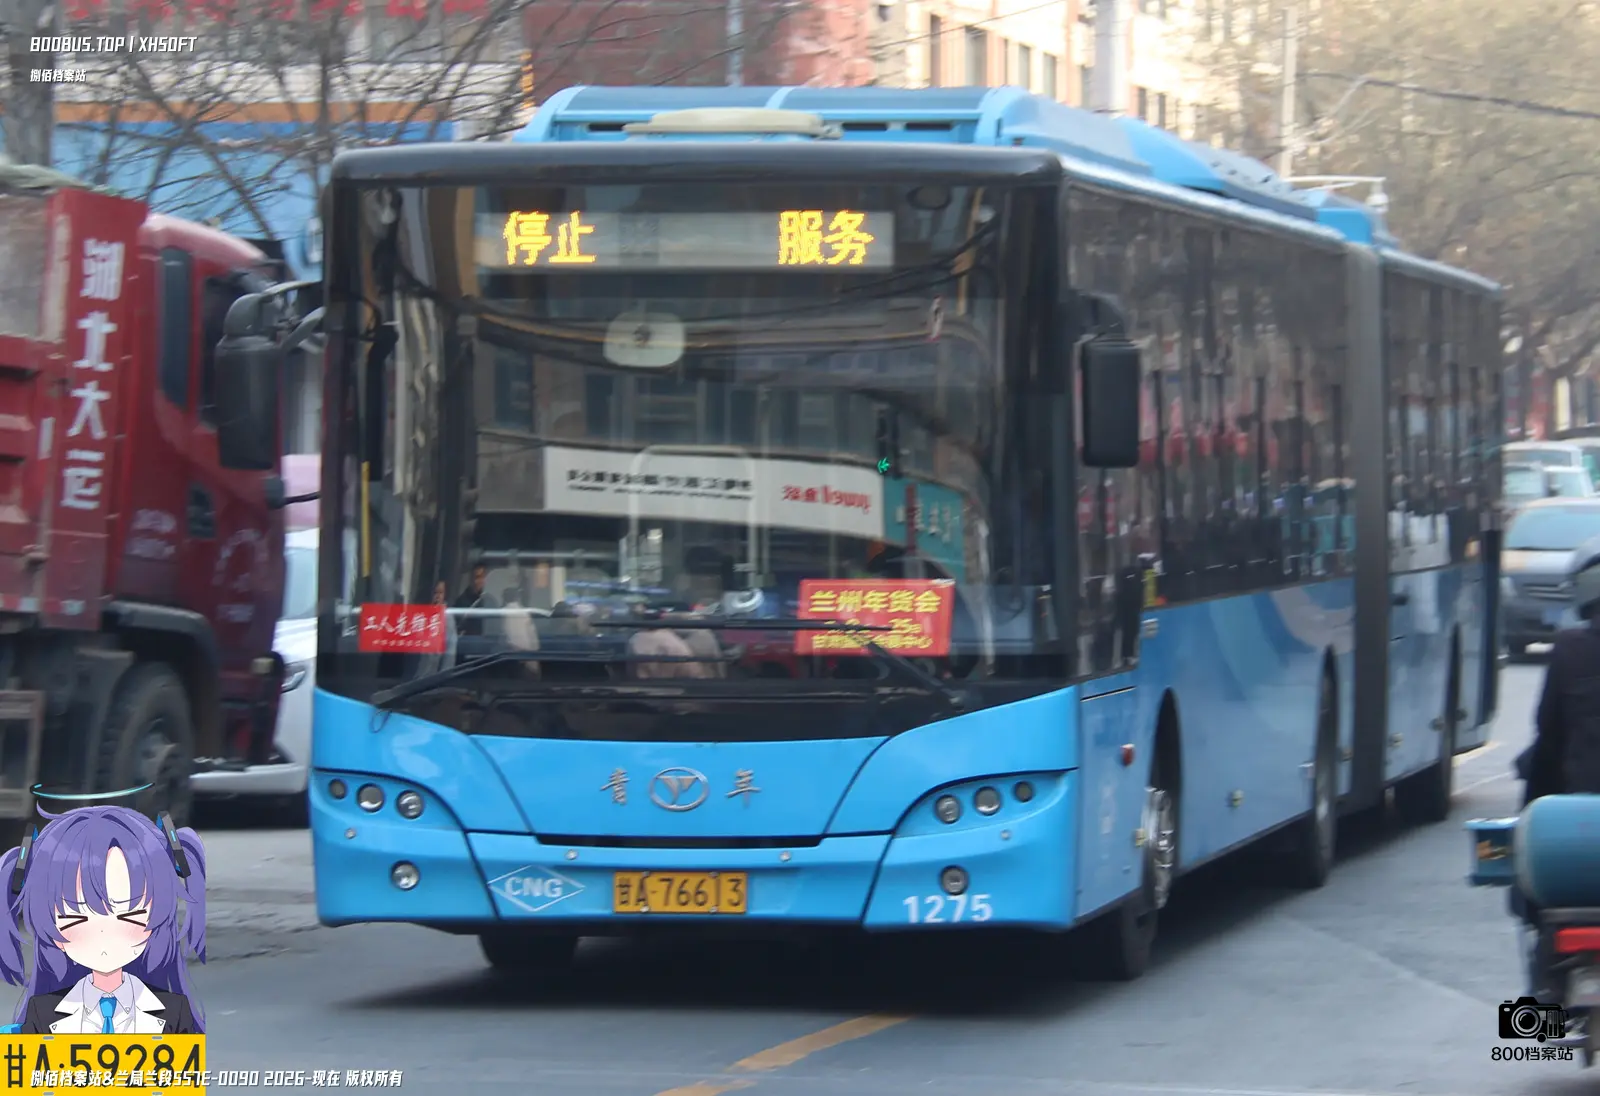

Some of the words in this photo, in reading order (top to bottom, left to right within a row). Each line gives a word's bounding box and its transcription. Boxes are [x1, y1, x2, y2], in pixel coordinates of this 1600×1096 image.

[502, 210, 597, 266] 停止
[777, 209, 875, 267] 服务
[808, 589, 942, 613] 兰州年货会
[504, 876, 564, 898] CNG
[903, 893, 994, 924] 1275
